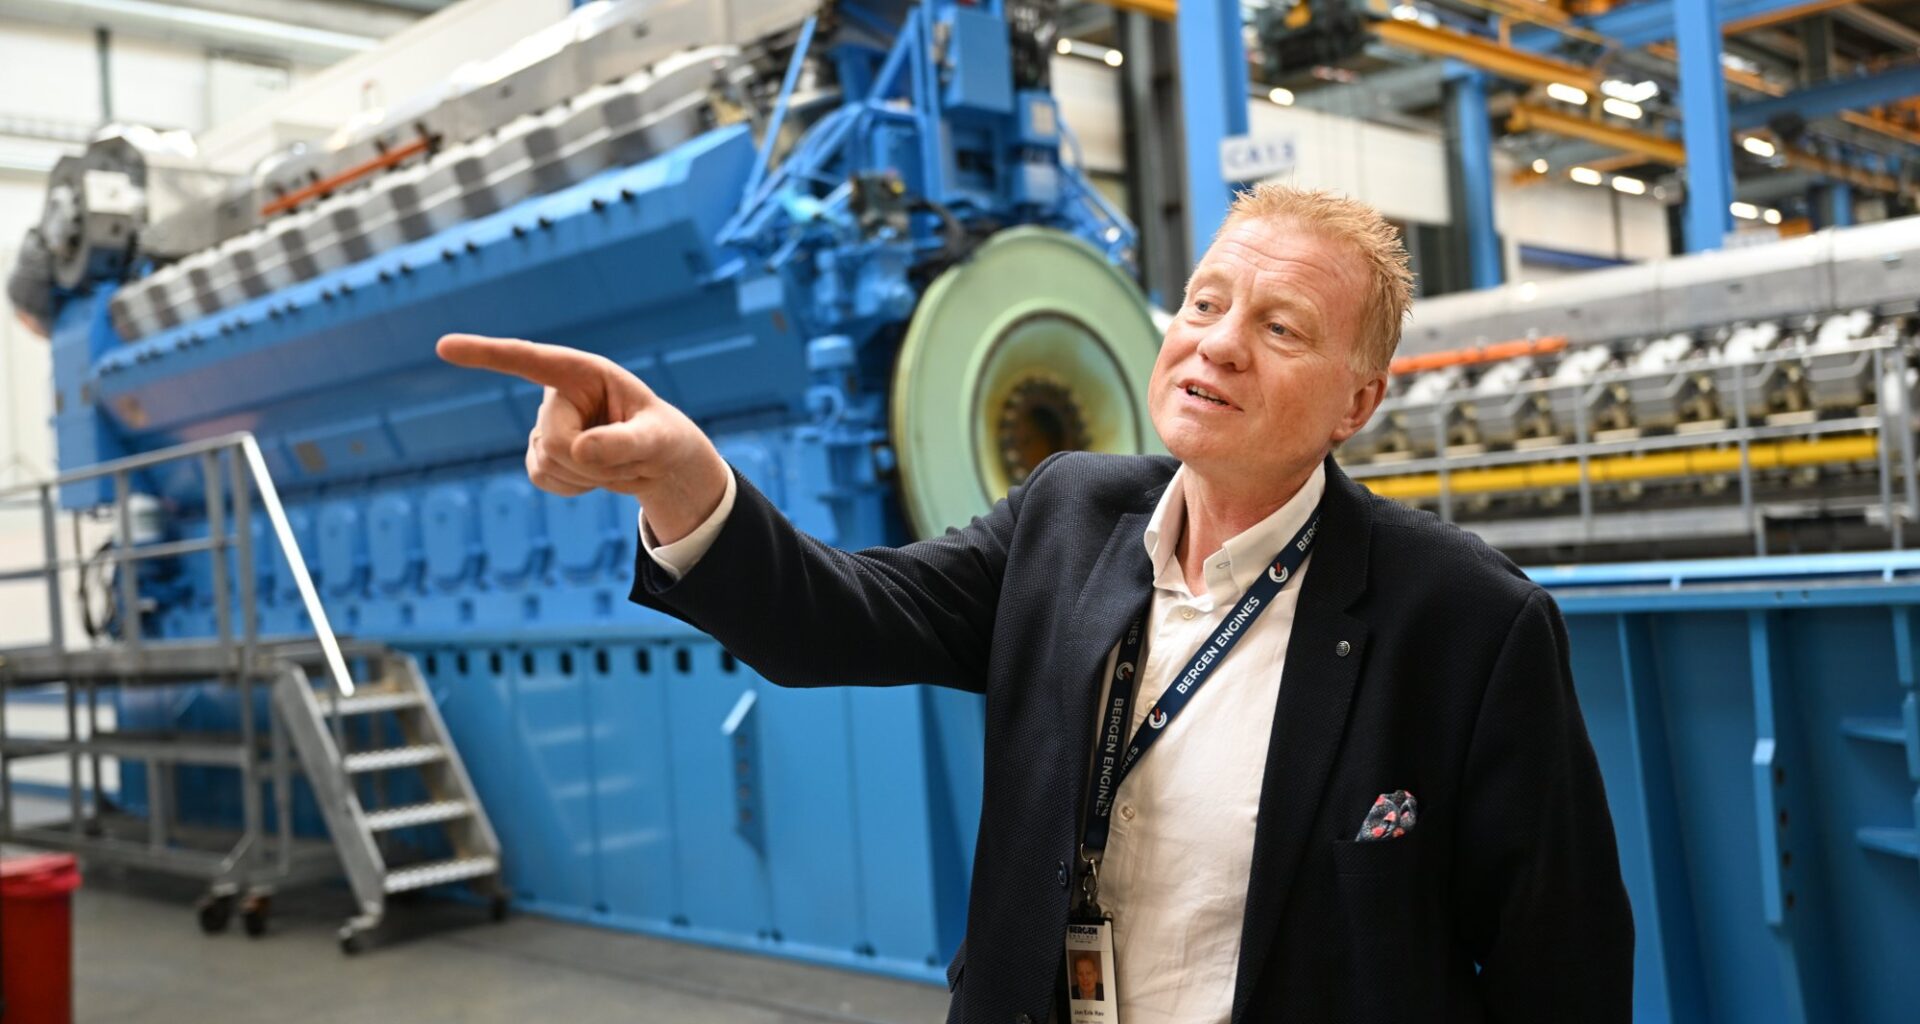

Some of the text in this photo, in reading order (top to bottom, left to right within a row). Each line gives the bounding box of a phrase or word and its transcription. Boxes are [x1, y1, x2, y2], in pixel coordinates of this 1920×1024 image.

[1176, 596, 1260, 694] BERGEN ENGINES
[1105, 697, 1124, 753] BERGEN
